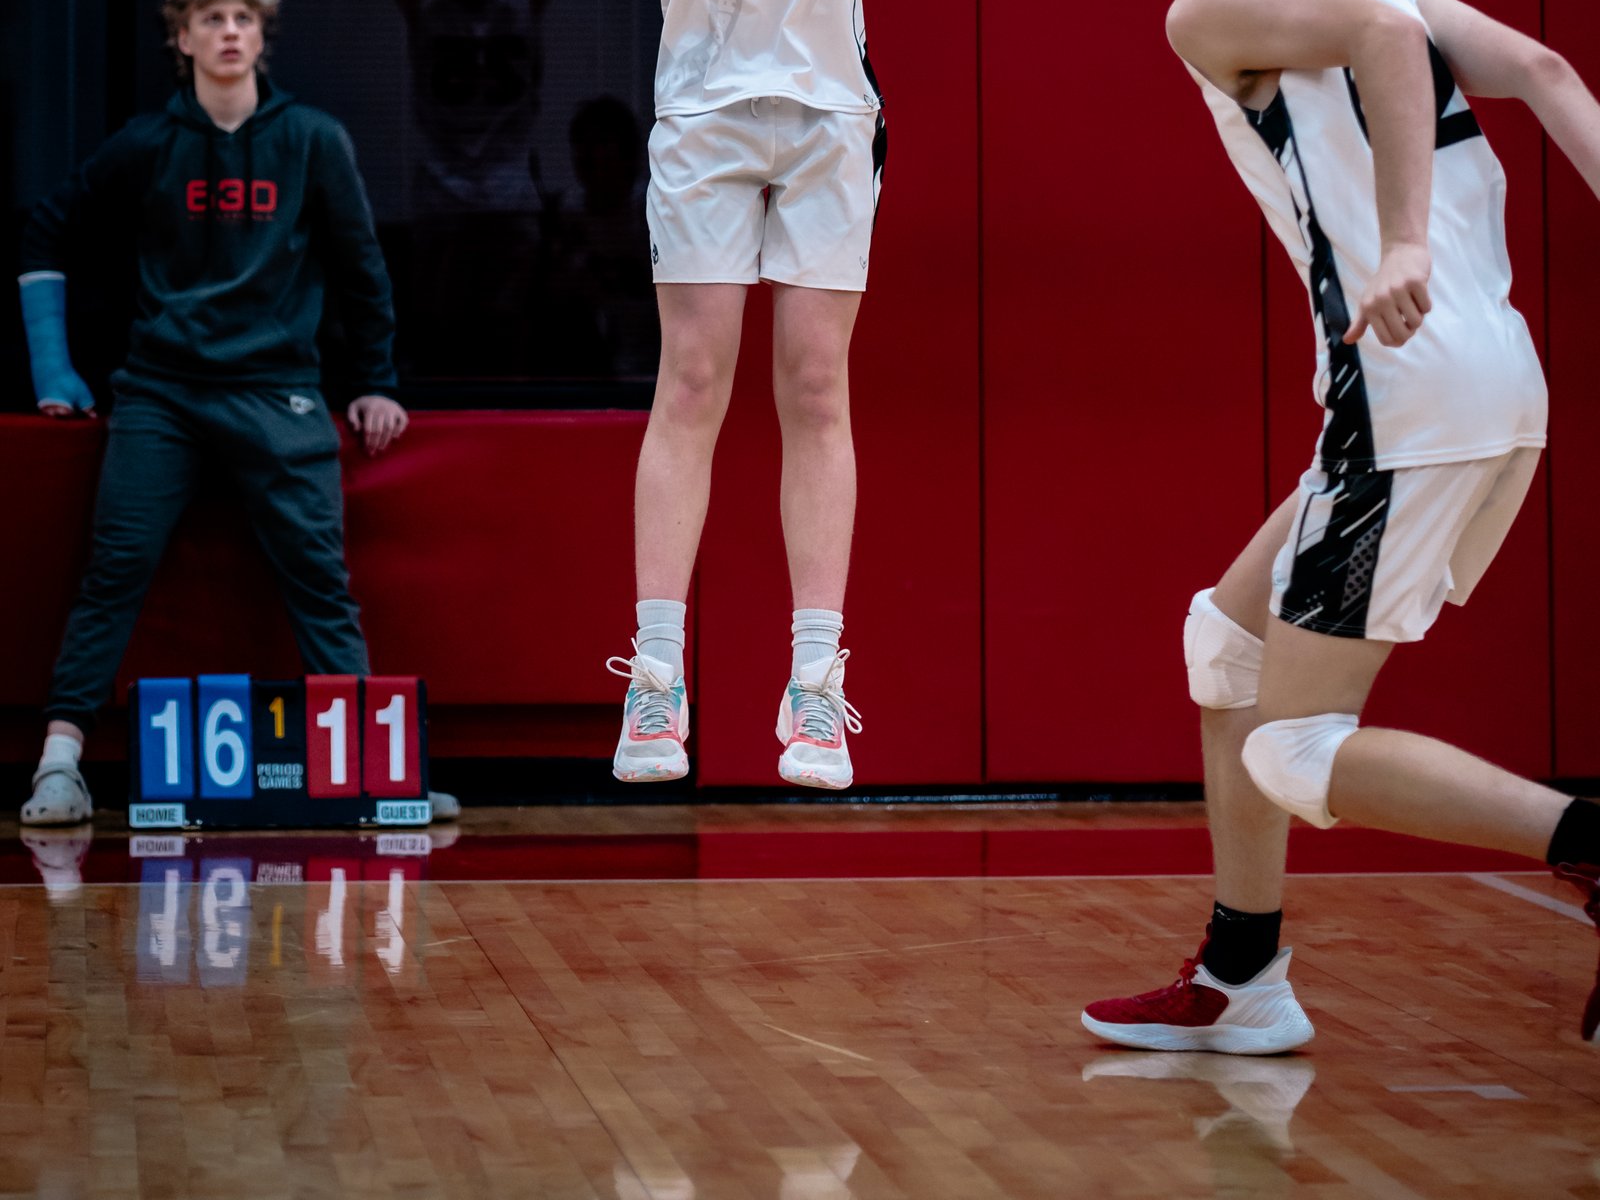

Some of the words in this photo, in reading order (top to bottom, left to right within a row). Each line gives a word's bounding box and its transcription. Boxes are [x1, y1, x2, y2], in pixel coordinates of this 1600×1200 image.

[268, 697, 285, 739] 1
[256, 763, 304, 776] PERIOD
[258, 775, 303, 789] GAMES
[136, 807, 178, 823] HOME
[380, 805, 427, 821] GUEST
